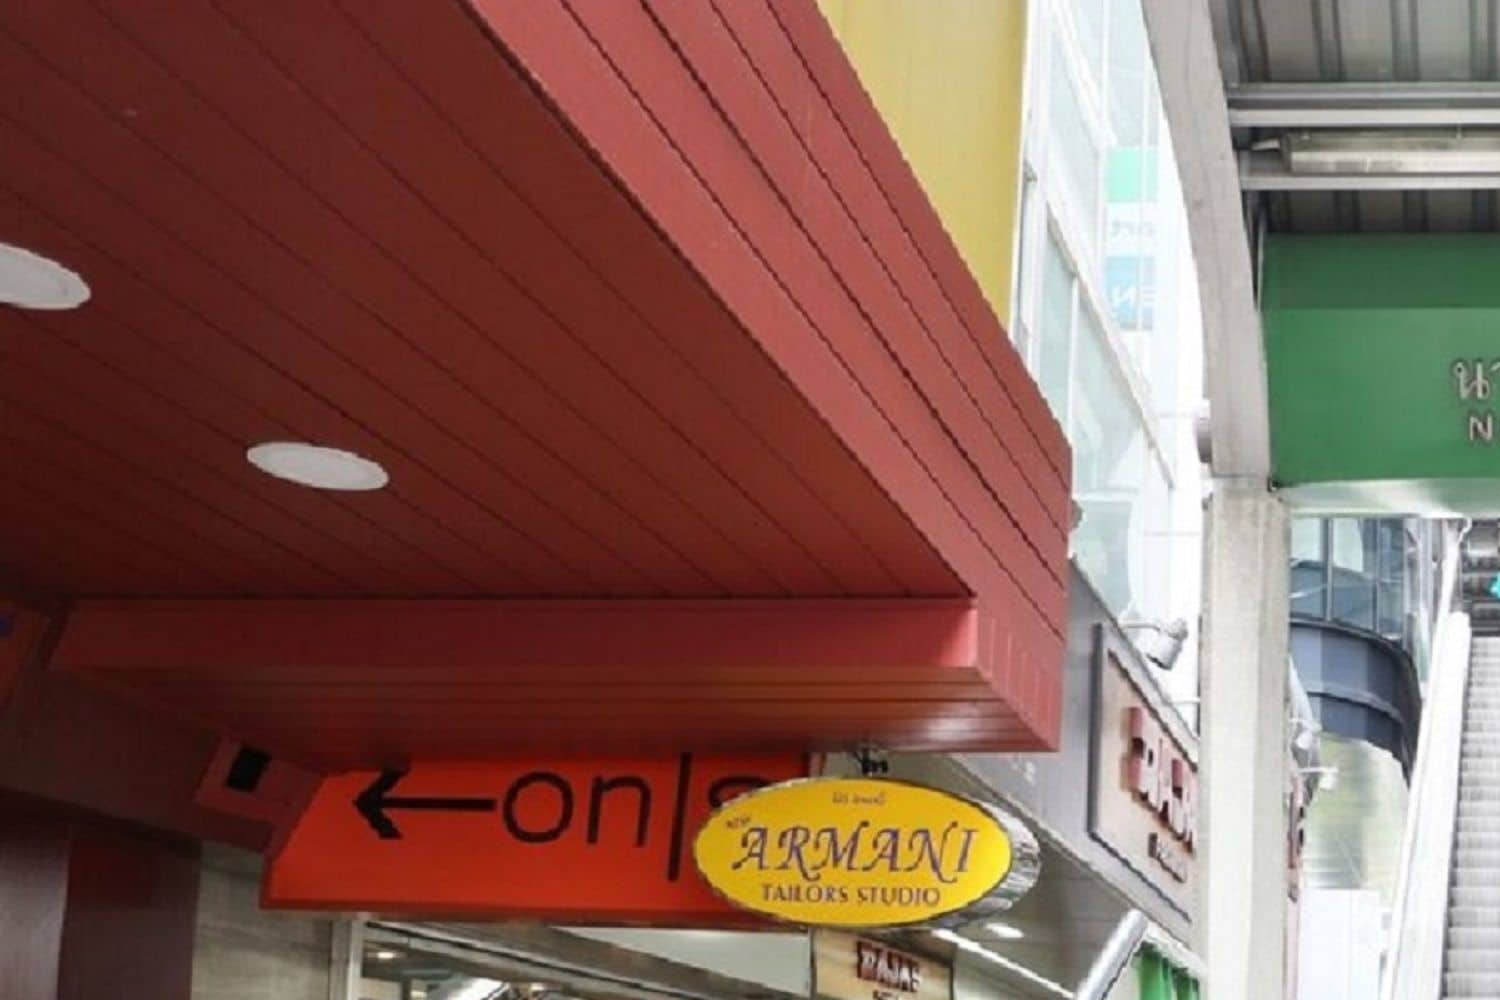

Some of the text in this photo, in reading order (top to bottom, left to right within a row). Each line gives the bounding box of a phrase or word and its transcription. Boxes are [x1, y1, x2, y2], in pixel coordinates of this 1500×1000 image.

[731, 820, 979, 883] ARMANI
[761, 883, 941, 907] TAILORS STUDIO
